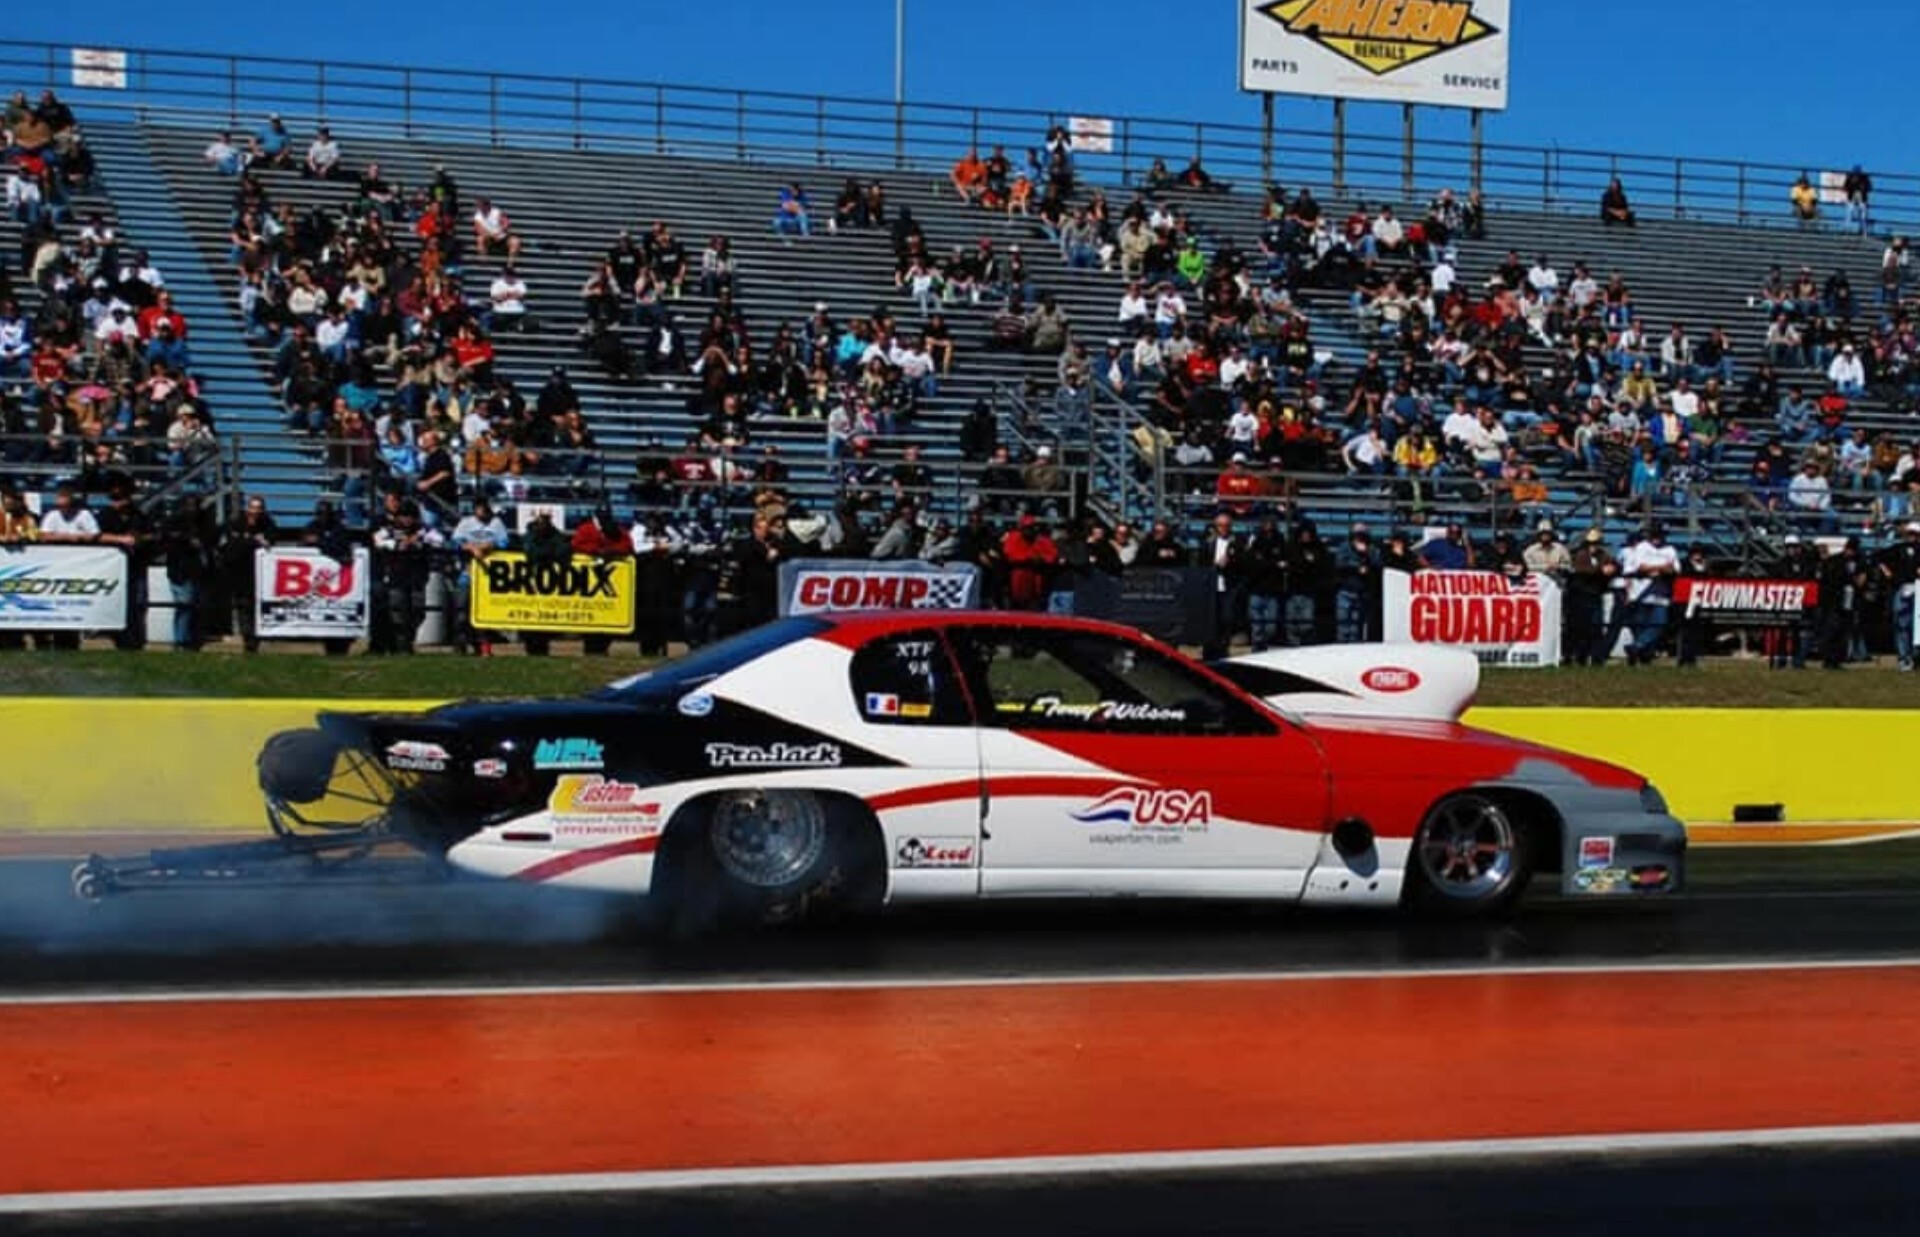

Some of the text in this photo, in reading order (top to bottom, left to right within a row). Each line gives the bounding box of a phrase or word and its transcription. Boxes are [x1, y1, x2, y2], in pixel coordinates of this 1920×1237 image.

[1286, 0, 1469, 44] AHERN
[1252, 58, 1298, 74] PARTS
[1353, 43, 1406, 60] RENTALS
[1443, 73, 1500, 91] SERVICE
[488, 559, 618, 598] BRODIX
[800, 575, 928, 608] COMP
[1411, 572, 1510, 595] NATIONAL
[1685, 581, 1805, 618] FLOWMASTER
[1410, 597, 1541, 643] GUARD
[1036, 697, 1186, 721] Tony Wilson
[1134, 790, 1212, 824] USA
